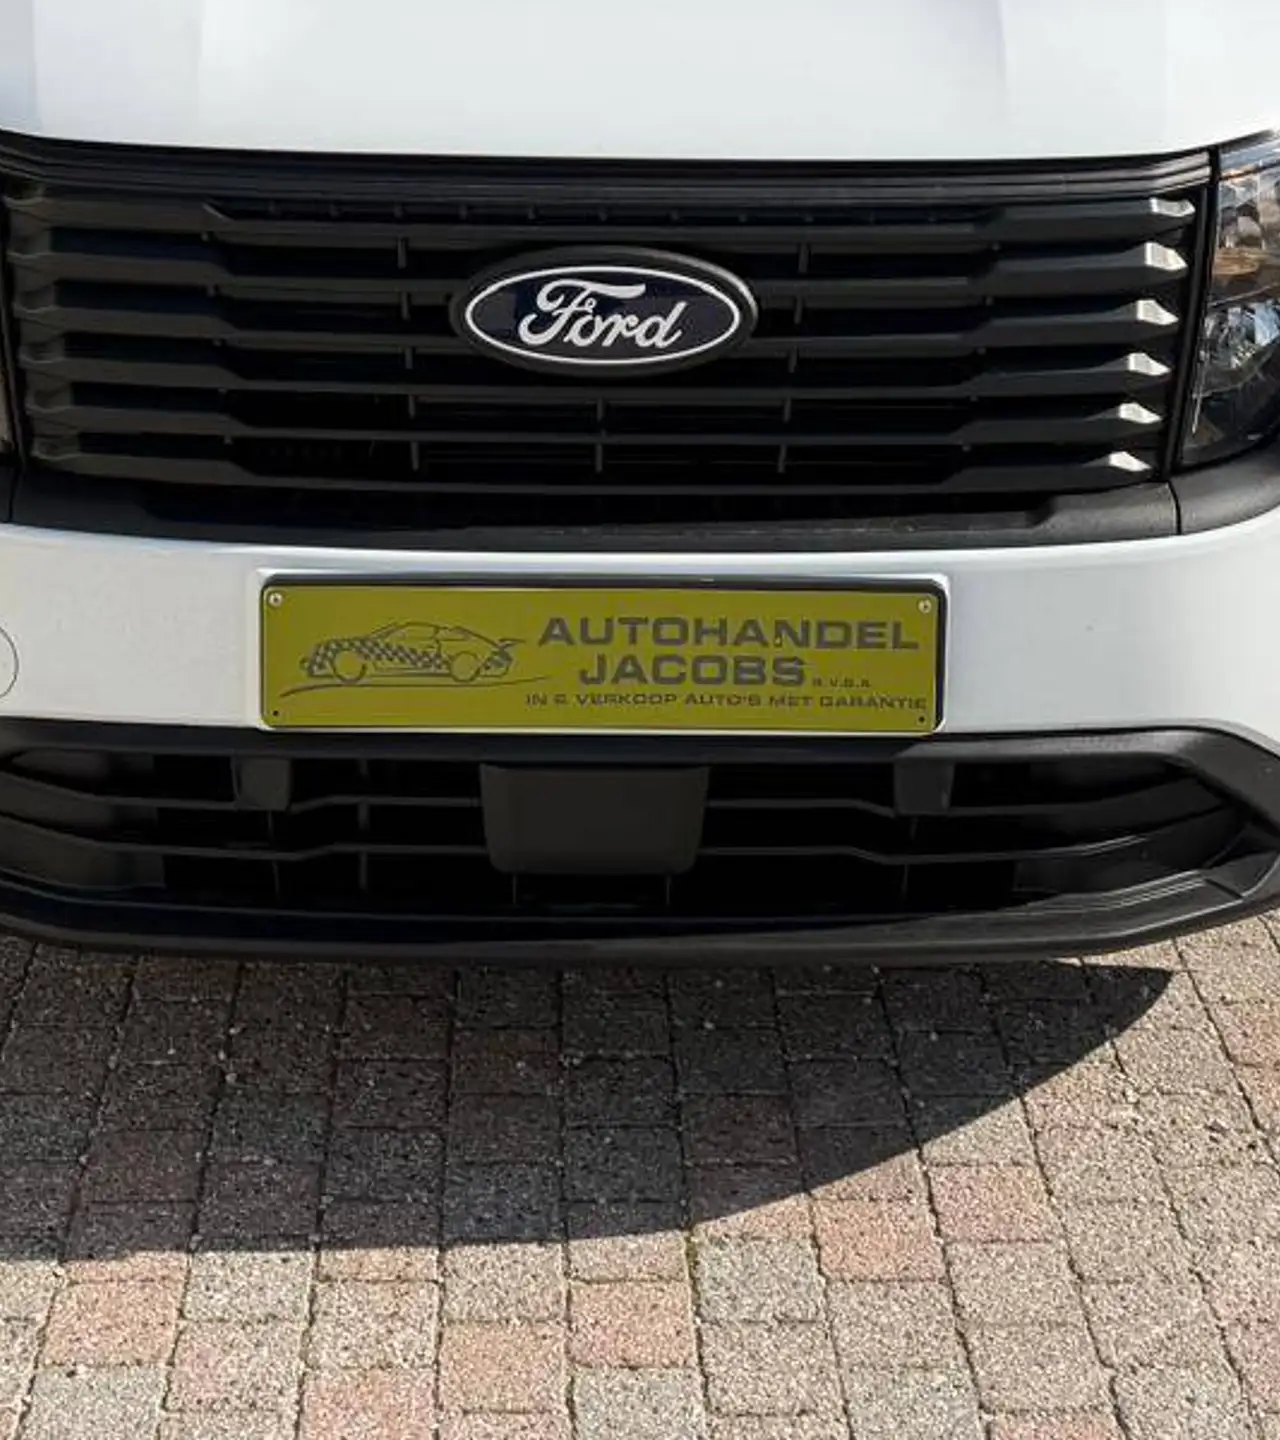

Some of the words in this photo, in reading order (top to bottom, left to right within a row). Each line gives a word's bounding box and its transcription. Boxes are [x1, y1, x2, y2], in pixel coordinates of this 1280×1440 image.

[518, 278, 688, 349] Ford
[537, 616, 920, 651] AUTOHANDEL
[578, 653, 807, 687] JACOBS
[525, 693, 548, 706] IN
[575, 693, 678, 707] VERKOOP
[685, 694, 762, 707] AUTO'S
[769, 695, 813, 707] MET
[819, 695, 927, 710] GARANTIE
